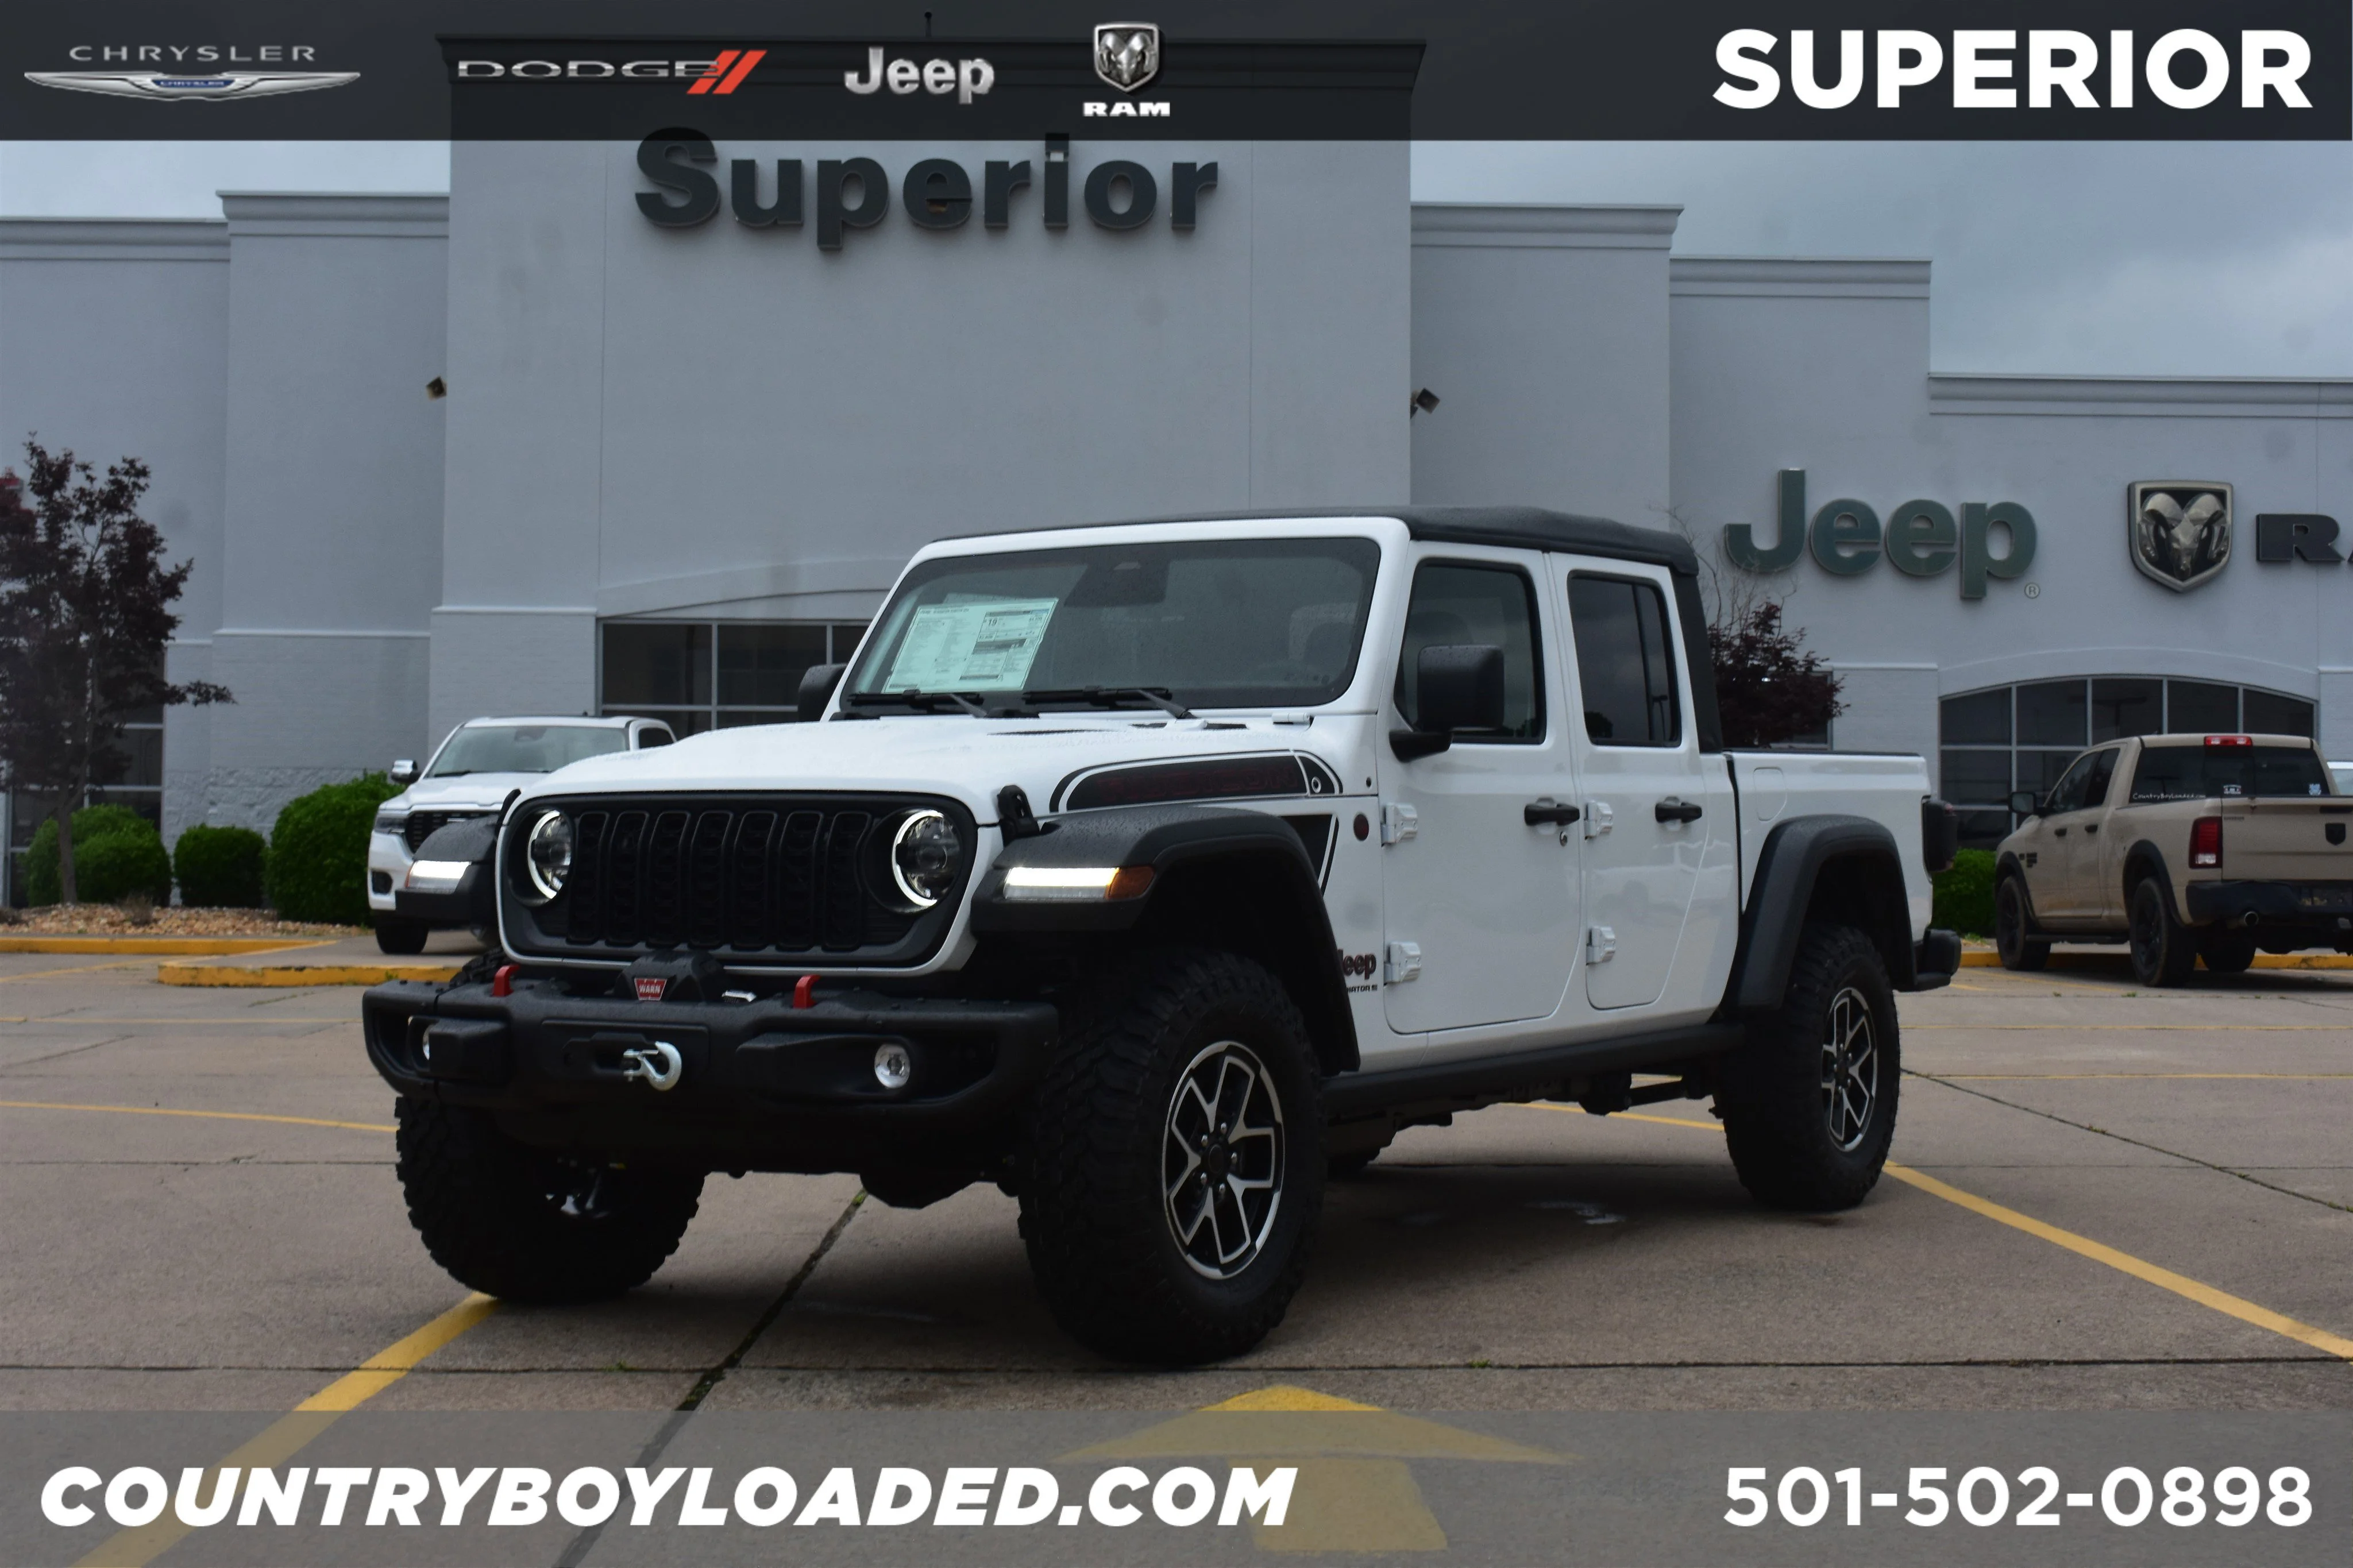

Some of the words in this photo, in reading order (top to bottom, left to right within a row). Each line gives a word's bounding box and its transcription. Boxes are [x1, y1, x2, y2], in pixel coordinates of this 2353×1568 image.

[634, 127, 1218, 252] Superior
[1725, 468, 2038, 599] Jeep
[2256, 513, 2353, 563] R
[639, 984, 661, 994] WARN
